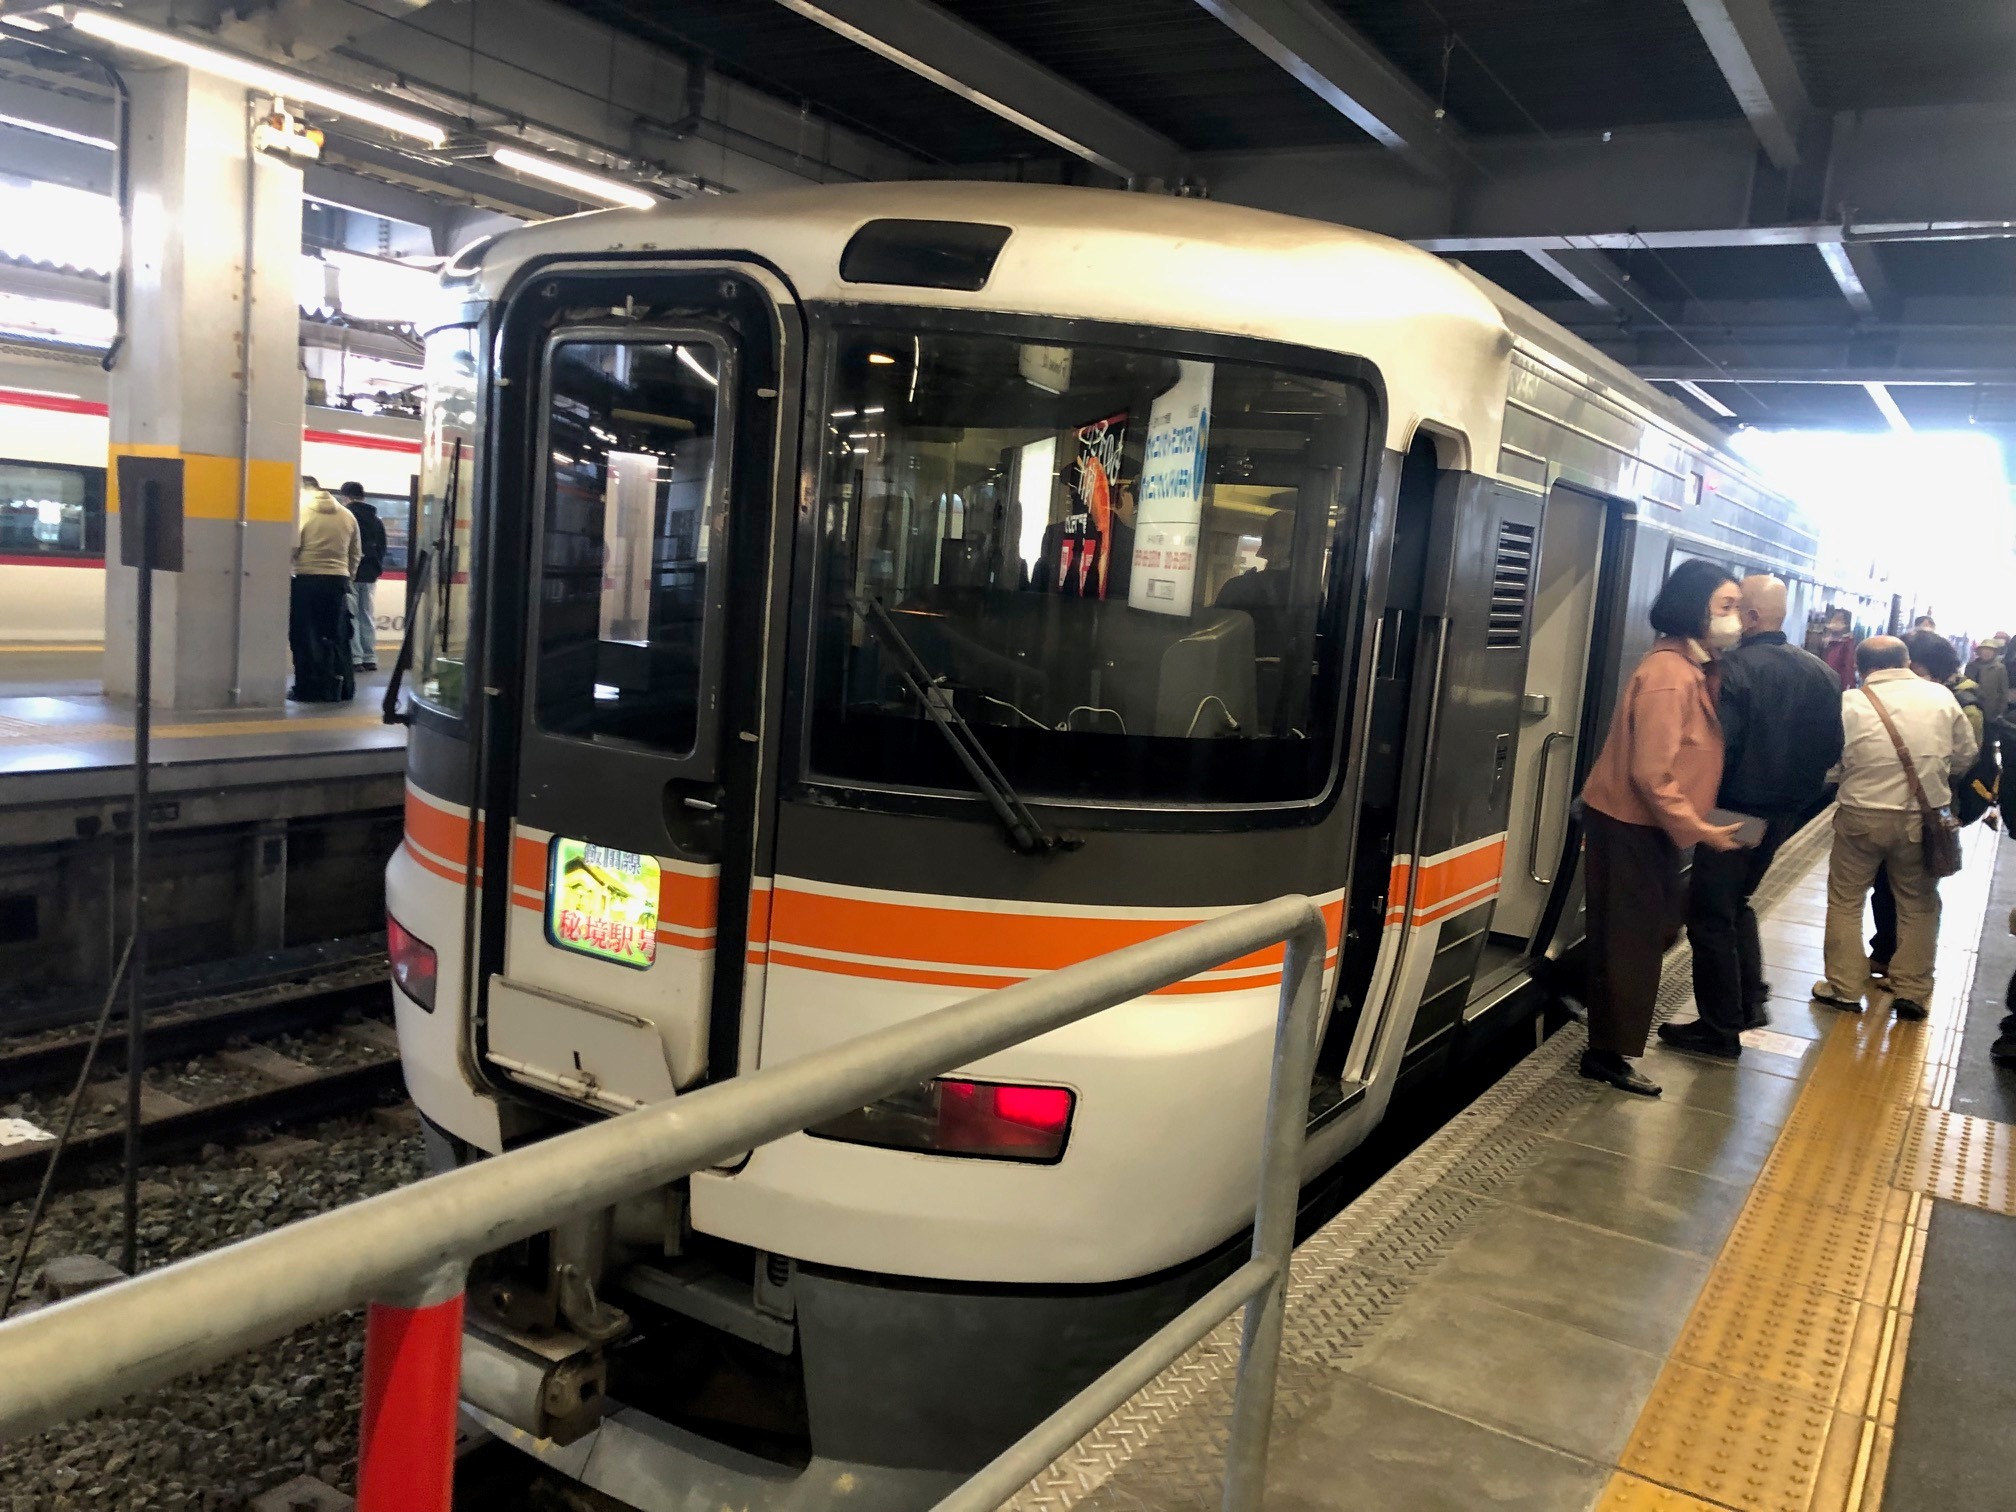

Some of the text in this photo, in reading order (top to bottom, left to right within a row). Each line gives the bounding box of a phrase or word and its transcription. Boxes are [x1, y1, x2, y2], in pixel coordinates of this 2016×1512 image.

[583, 843, 641, 875] 飯田線
[559, 909, 656, 962] 秘境駅号
